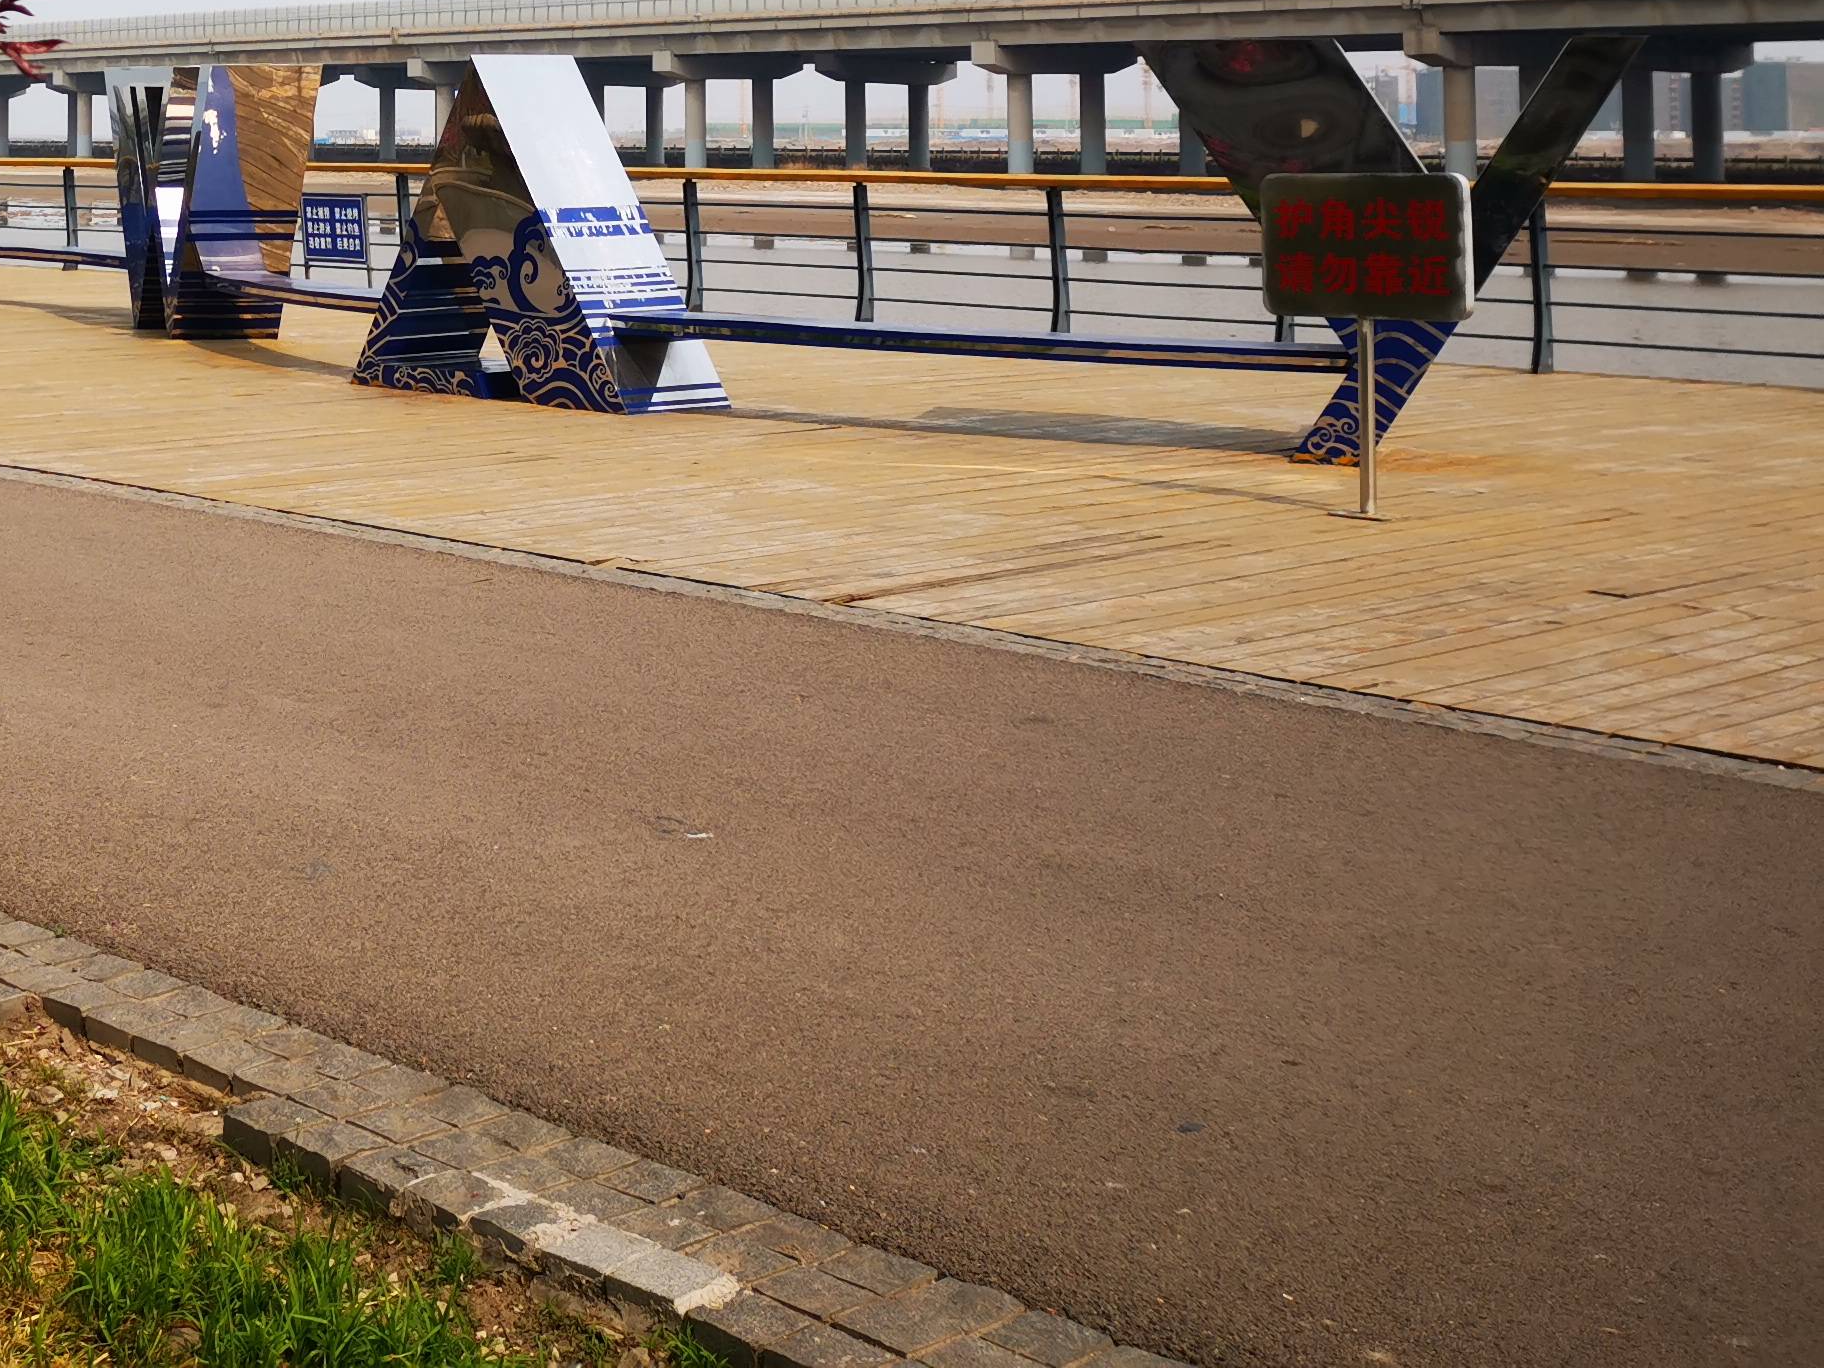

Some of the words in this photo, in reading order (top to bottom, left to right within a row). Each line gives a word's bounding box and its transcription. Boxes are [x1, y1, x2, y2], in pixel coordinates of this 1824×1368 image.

[1273, 197, 1451, 241] 护角尖锐
[1274, 252, 1452, 296] 请勿靠近
